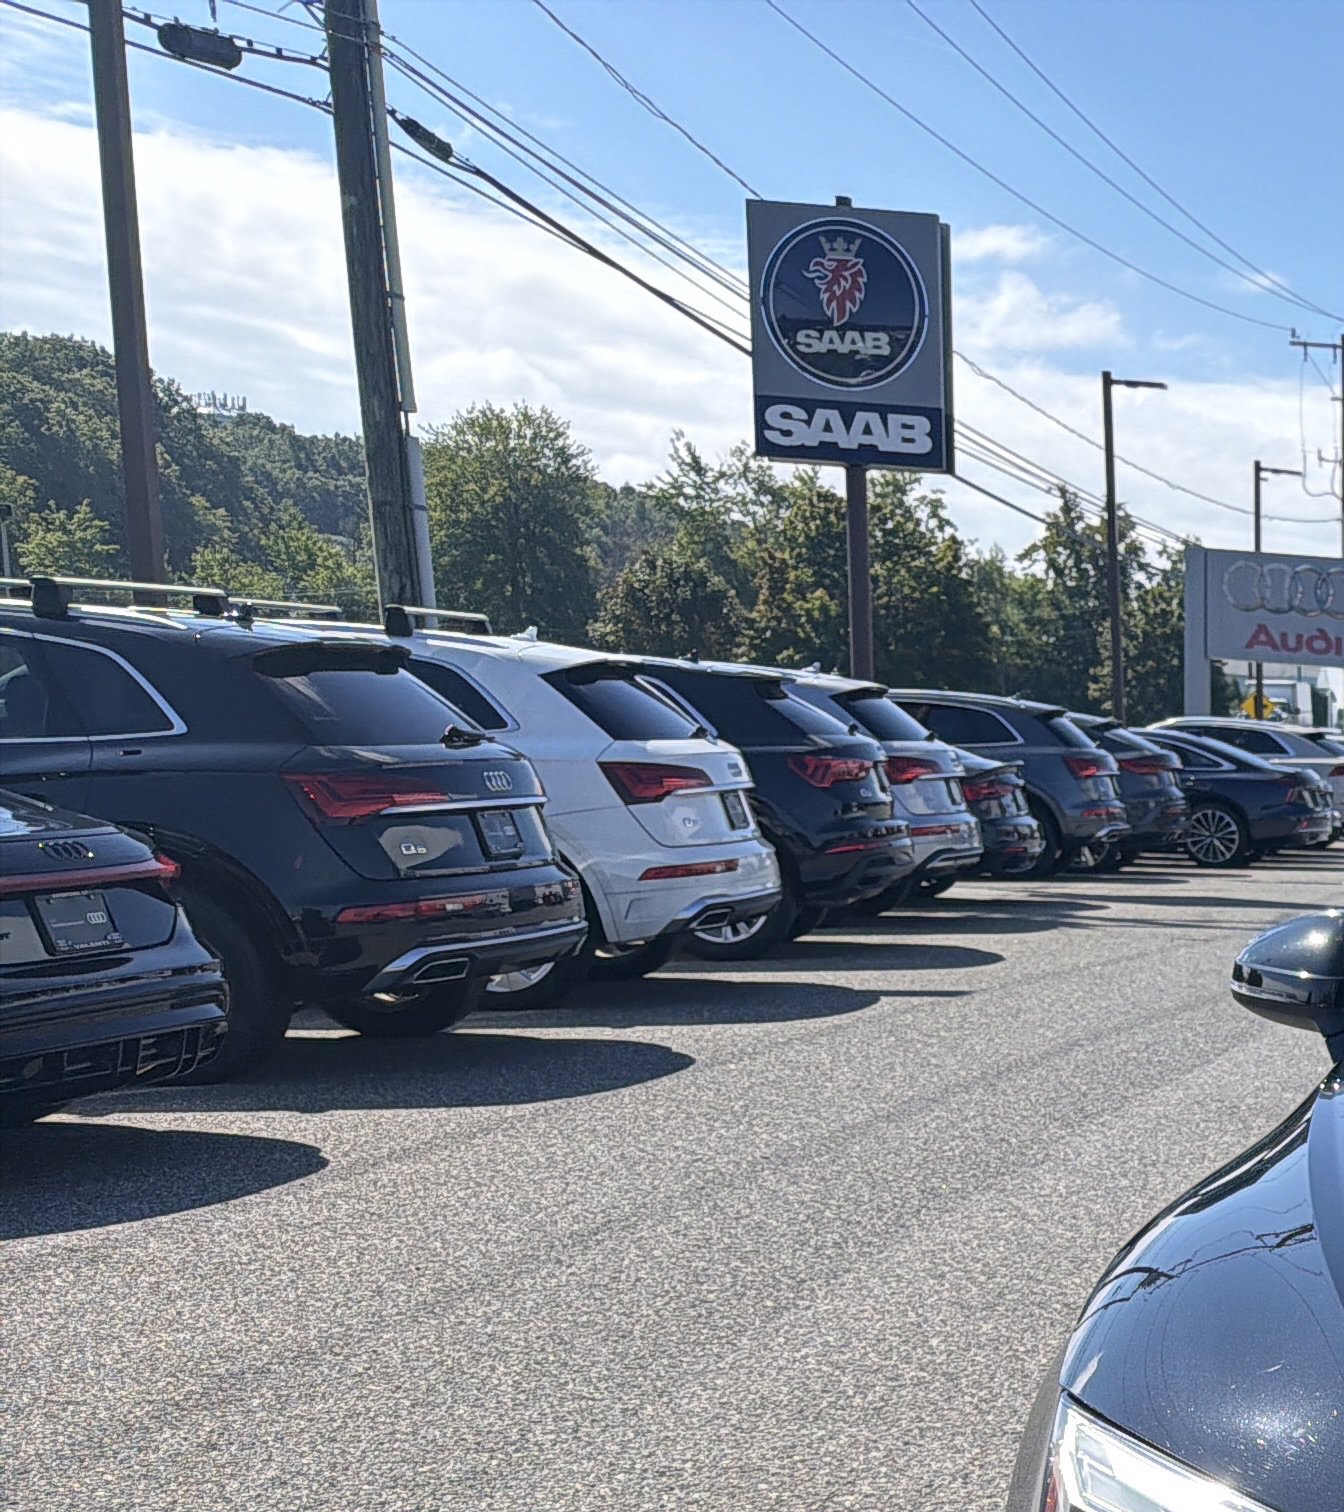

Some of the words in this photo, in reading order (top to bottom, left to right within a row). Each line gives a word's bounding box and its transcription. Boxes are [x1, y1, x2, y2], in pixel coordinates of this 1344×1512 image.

[795, 330, 891, 356] SAAB
[764, 404, 933, 454] SAAB
[1245, 623, 1342, 656] Audi
